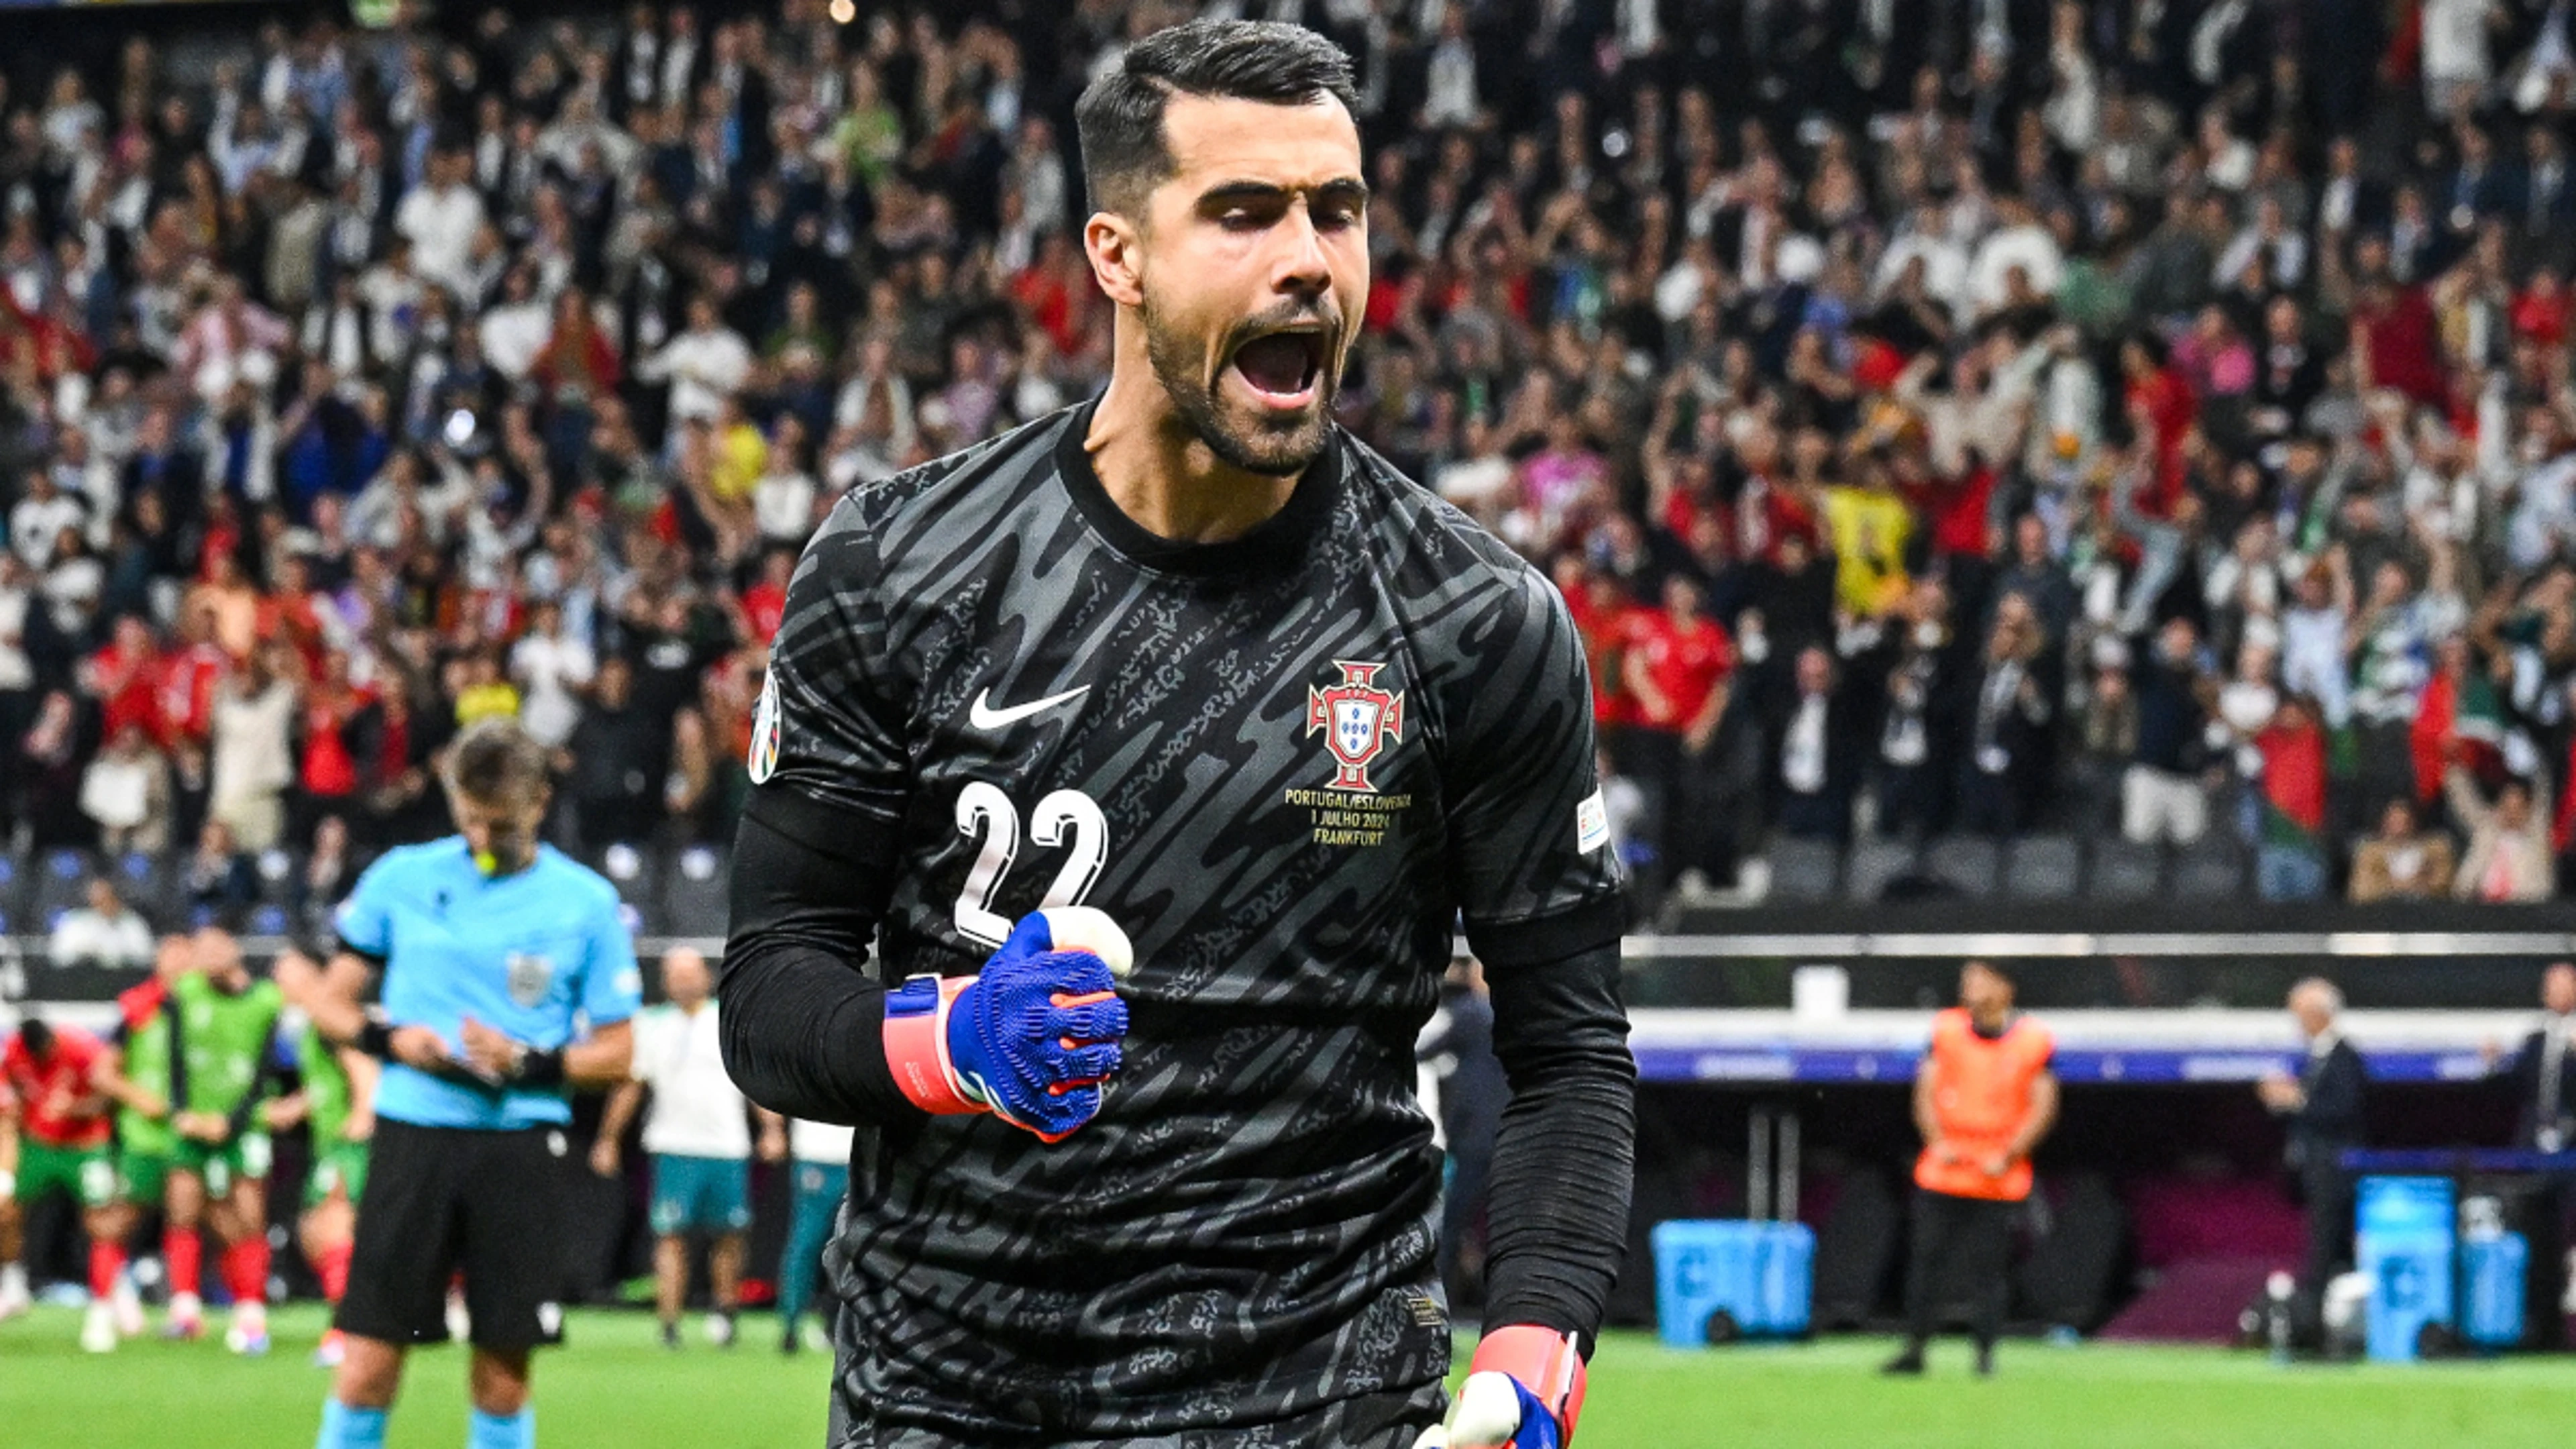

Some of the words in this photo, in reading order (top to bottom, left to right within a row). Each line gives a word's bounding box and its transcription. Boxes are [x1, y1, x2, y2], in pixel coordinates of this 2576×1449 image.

[1311, 809, 1317, 825] 1
[1320, 810, 1360, 827] JULHO
[1313, 828, 1385, 846] FRANKFURT
[954, 781, 1108, 949] 22
